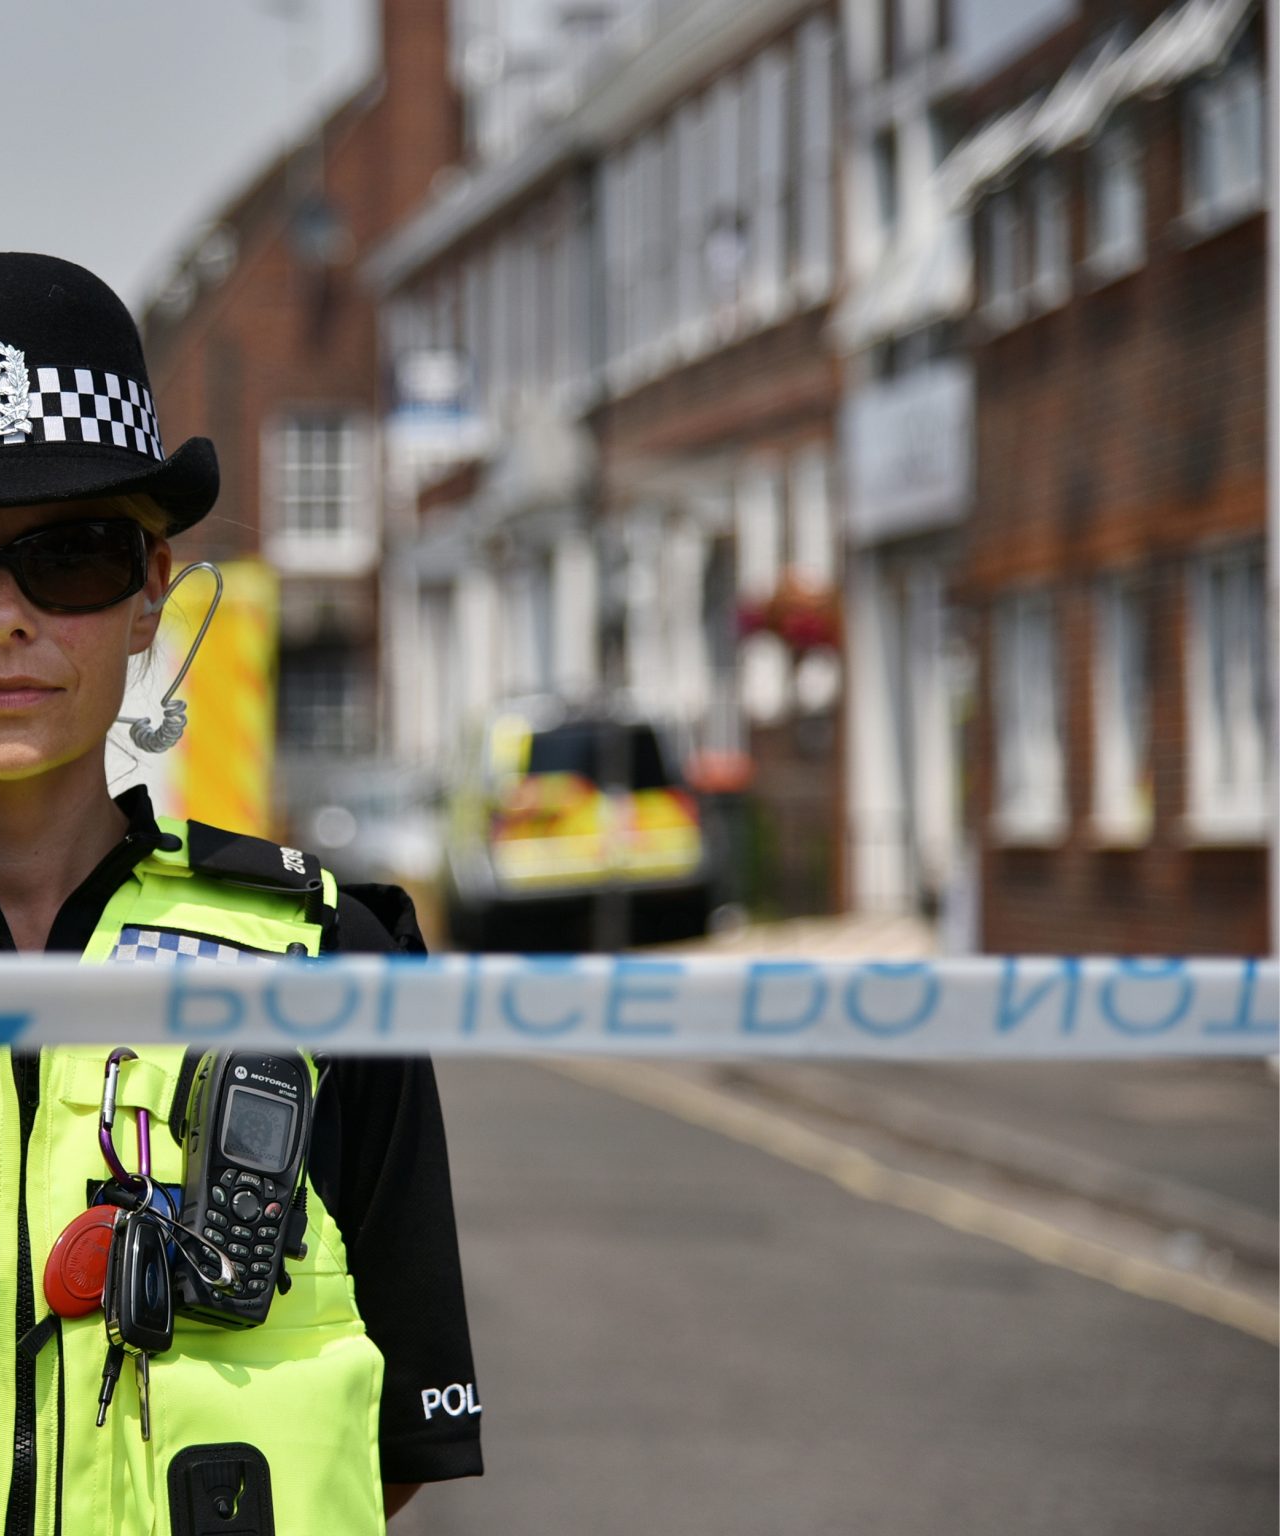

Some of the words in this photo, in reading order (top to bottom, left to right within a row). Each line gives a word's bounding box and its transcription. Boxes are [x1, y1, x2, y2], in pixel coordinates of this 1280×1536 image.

[250, 1073, 297, 1092] MOTOROLA
[241, 1175, 261, 1186] MENU
[421, 1383, 483, 1420] POL
